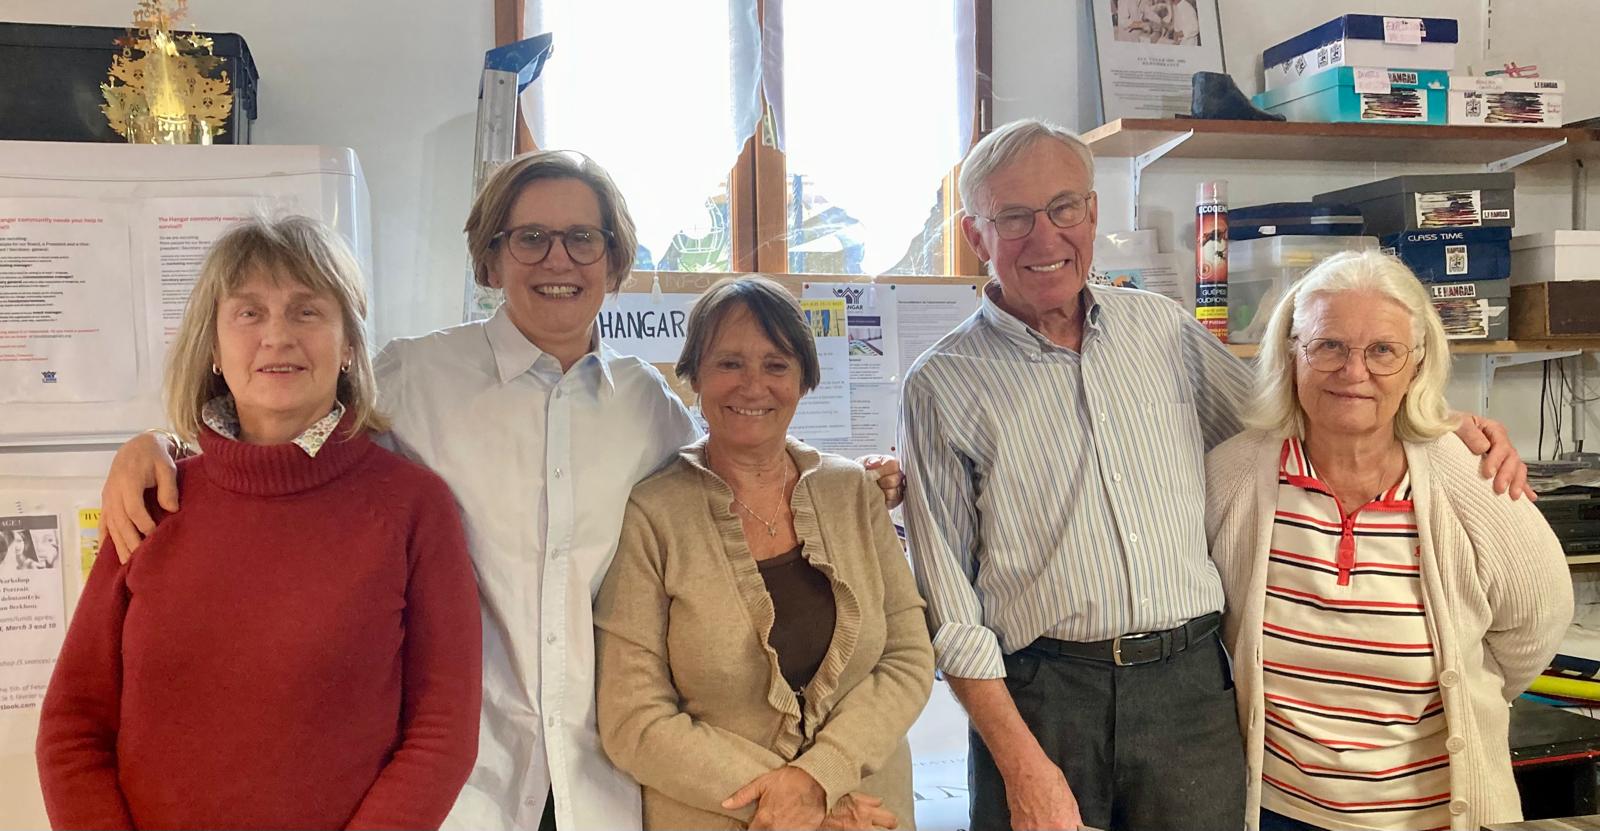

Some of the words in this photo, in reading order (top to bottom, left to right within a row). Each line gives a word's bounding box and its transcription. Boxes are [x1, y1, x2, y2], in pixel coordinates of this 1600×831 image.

[1408, 233, 1438, 242] CLASS
[1440, 232, 1464, 240] TIME
[1432, 287, 1444, 298] LE
[1444, 285, 1475, 297] HANGAR
[598, 310, 686, 340] HANGAR
[1, 519, 18, 527] AGE
[6, 624, 27, 632] March
[0, 702, 36, 711] tlook.com
